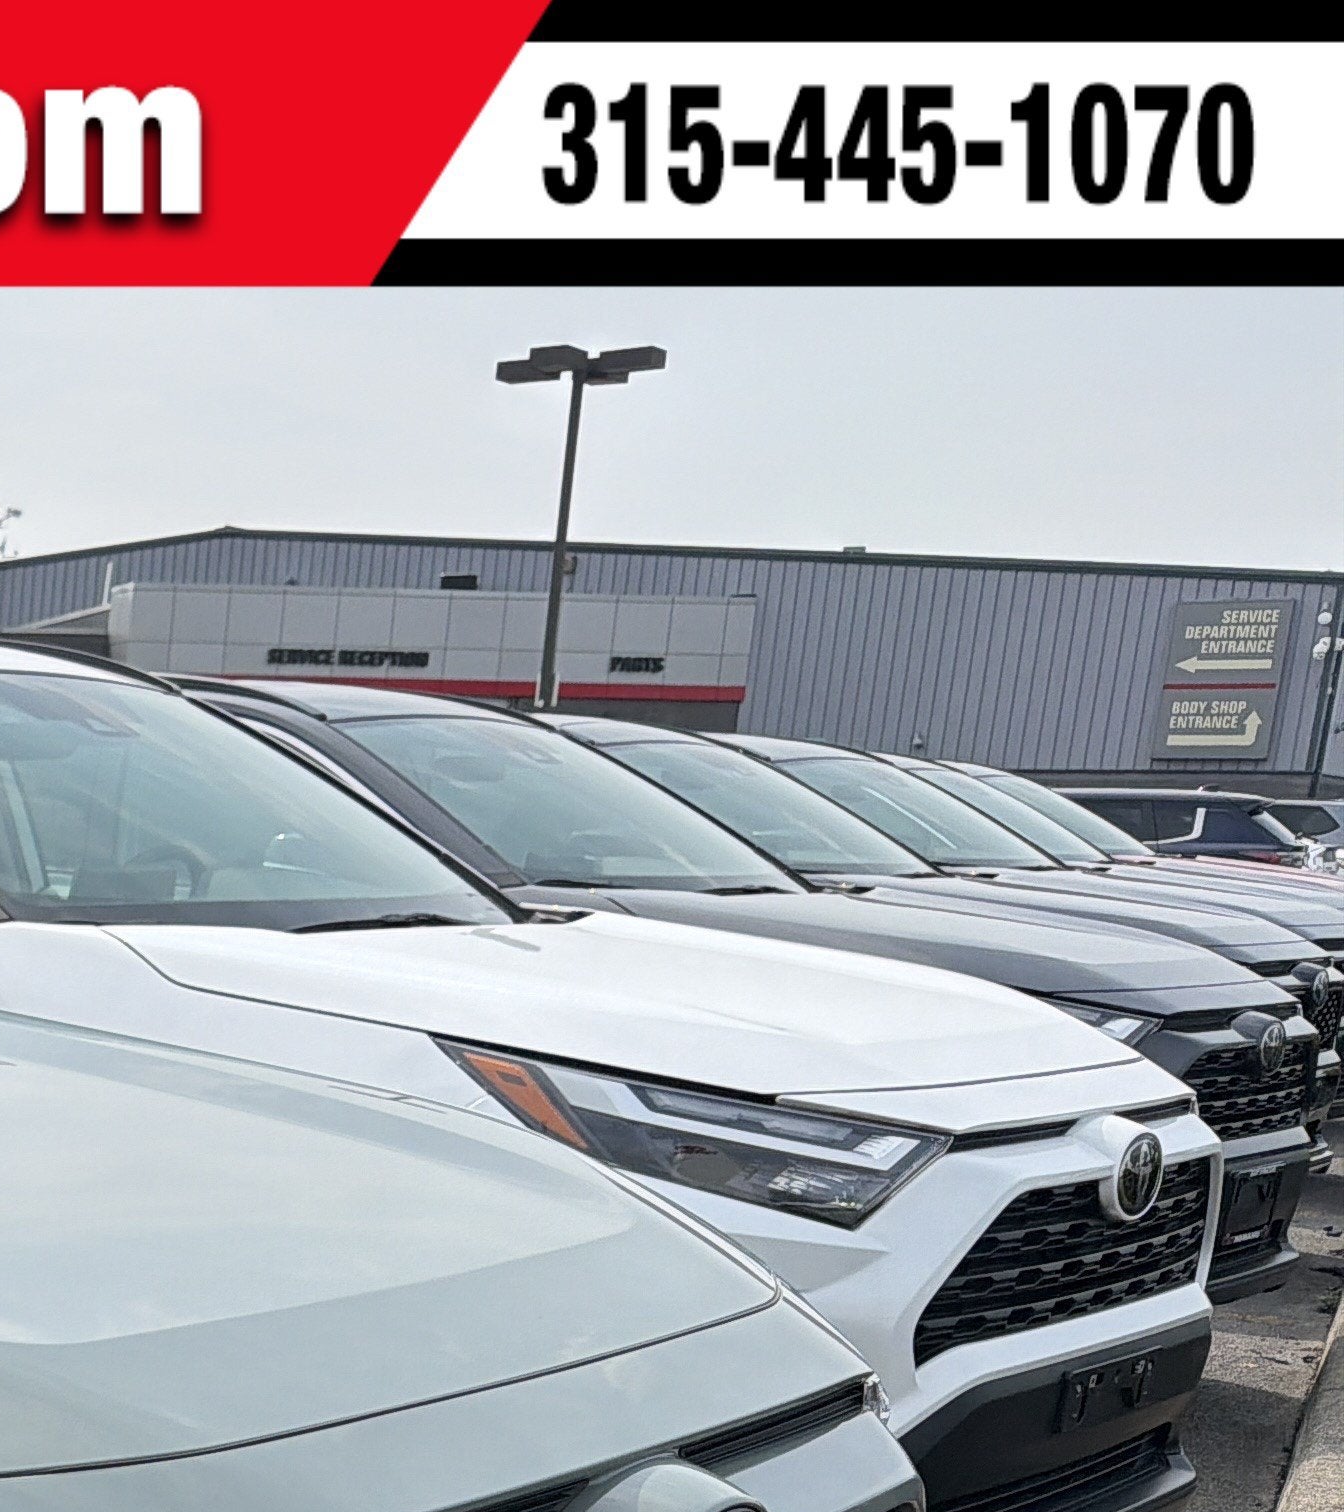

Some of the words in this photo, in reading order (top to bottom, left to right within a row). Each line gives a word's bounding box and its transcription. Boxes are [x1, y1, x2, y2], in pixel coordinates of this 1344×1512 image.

[1221, 609, 1281, 624] SERVICE
[1185, 625, 1279, 639] DEPARTMENT
[1201, 640, 1275, 653] ENTRANCE
[268, 649, 336, 665] SERVICE
[338, 650, 430, 668] RECEPTION
[610, 656, 665, 673] PARTS
[1172, 701, 1208, 714] BODY
[1211, 700, 1247, 714] SHOP
[1169, 716, 1240, 729] ENTRANCE
